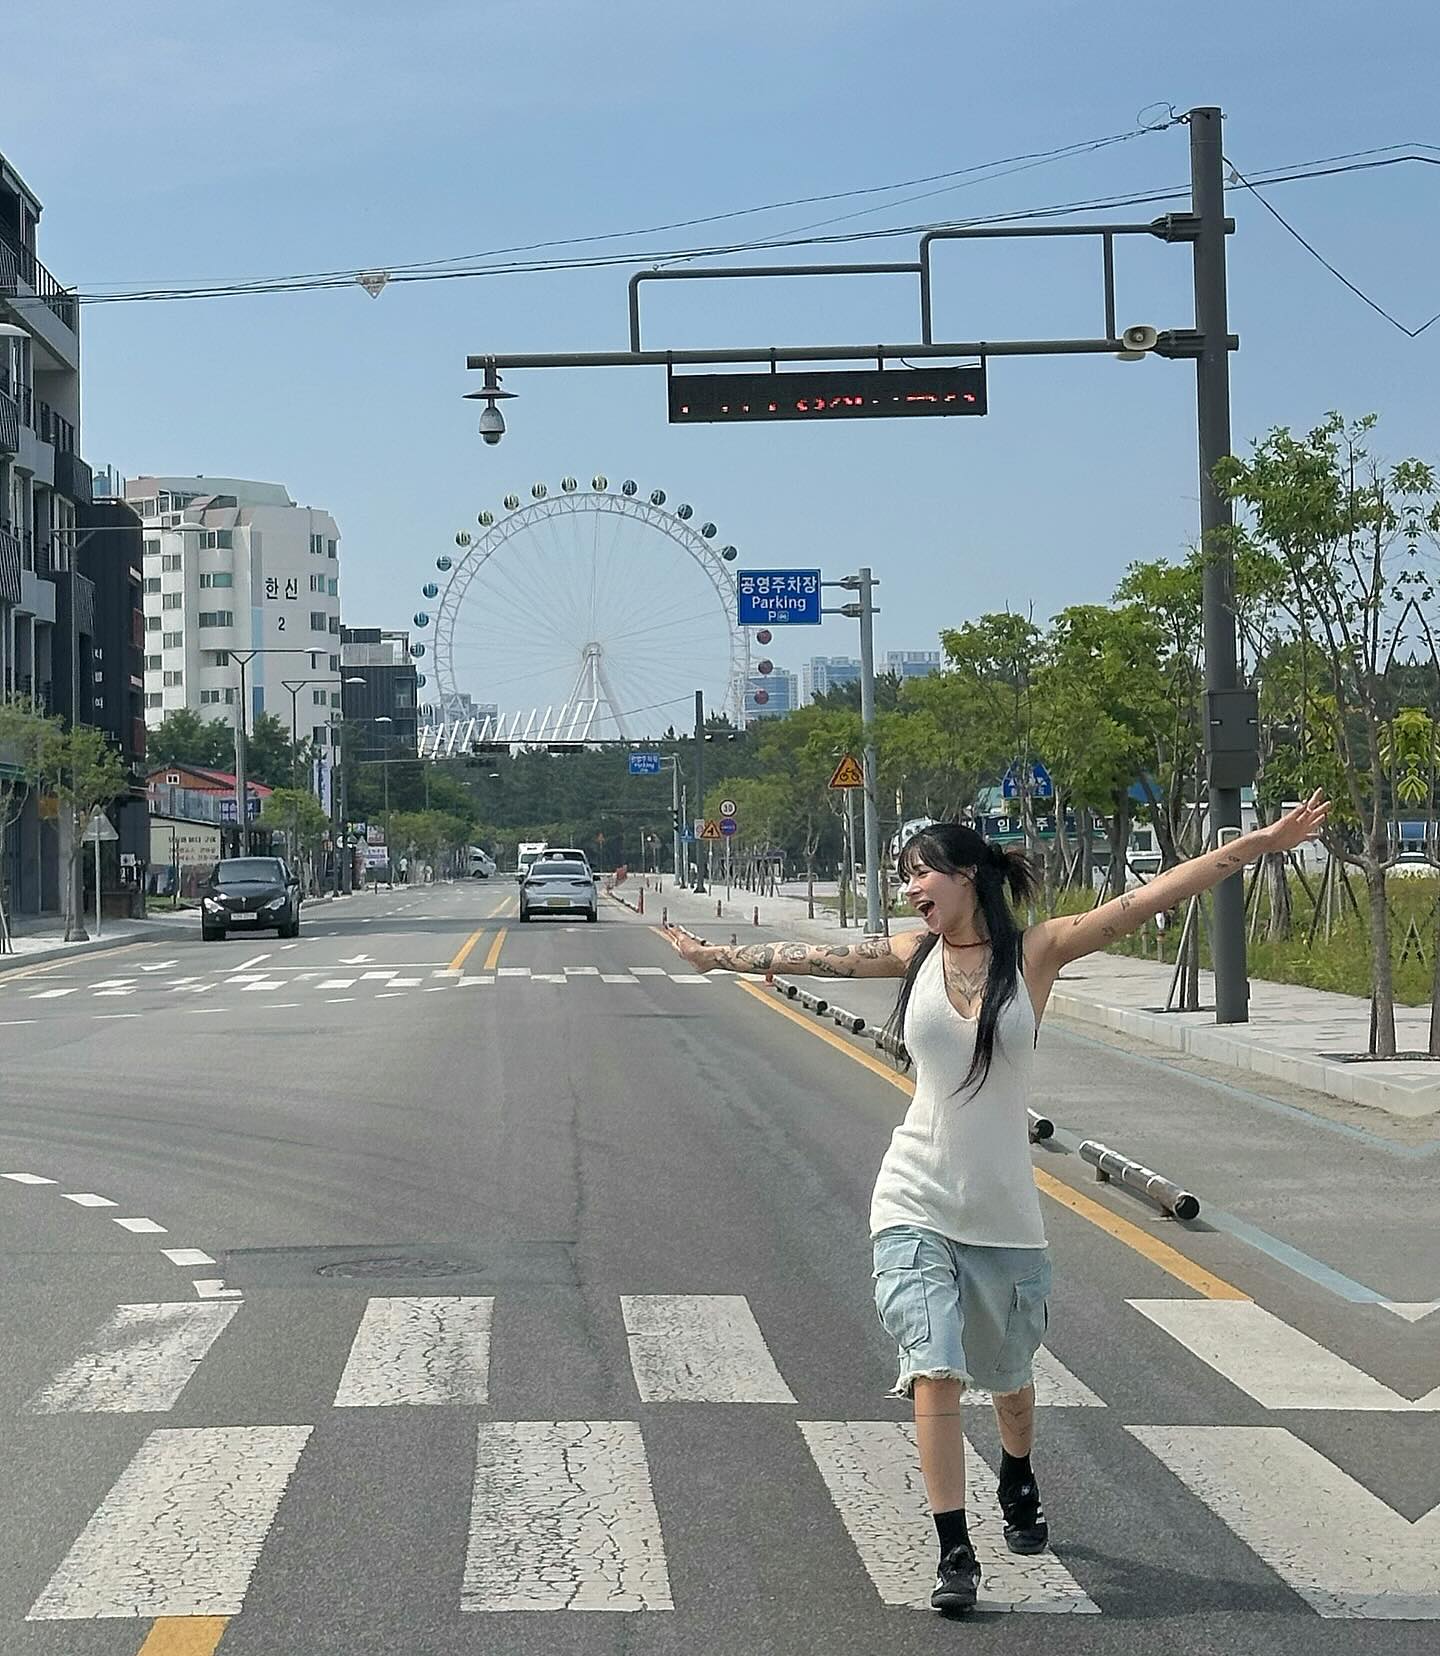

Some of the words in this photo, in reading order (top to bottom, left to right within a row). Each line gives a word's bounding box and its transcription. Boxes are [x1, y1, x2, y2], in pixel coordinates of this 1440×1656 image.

[741, 576, 817, 594] 공영주차장
[752, 595, 806, 611] Parking
[278, 616, 285, 631] 2
